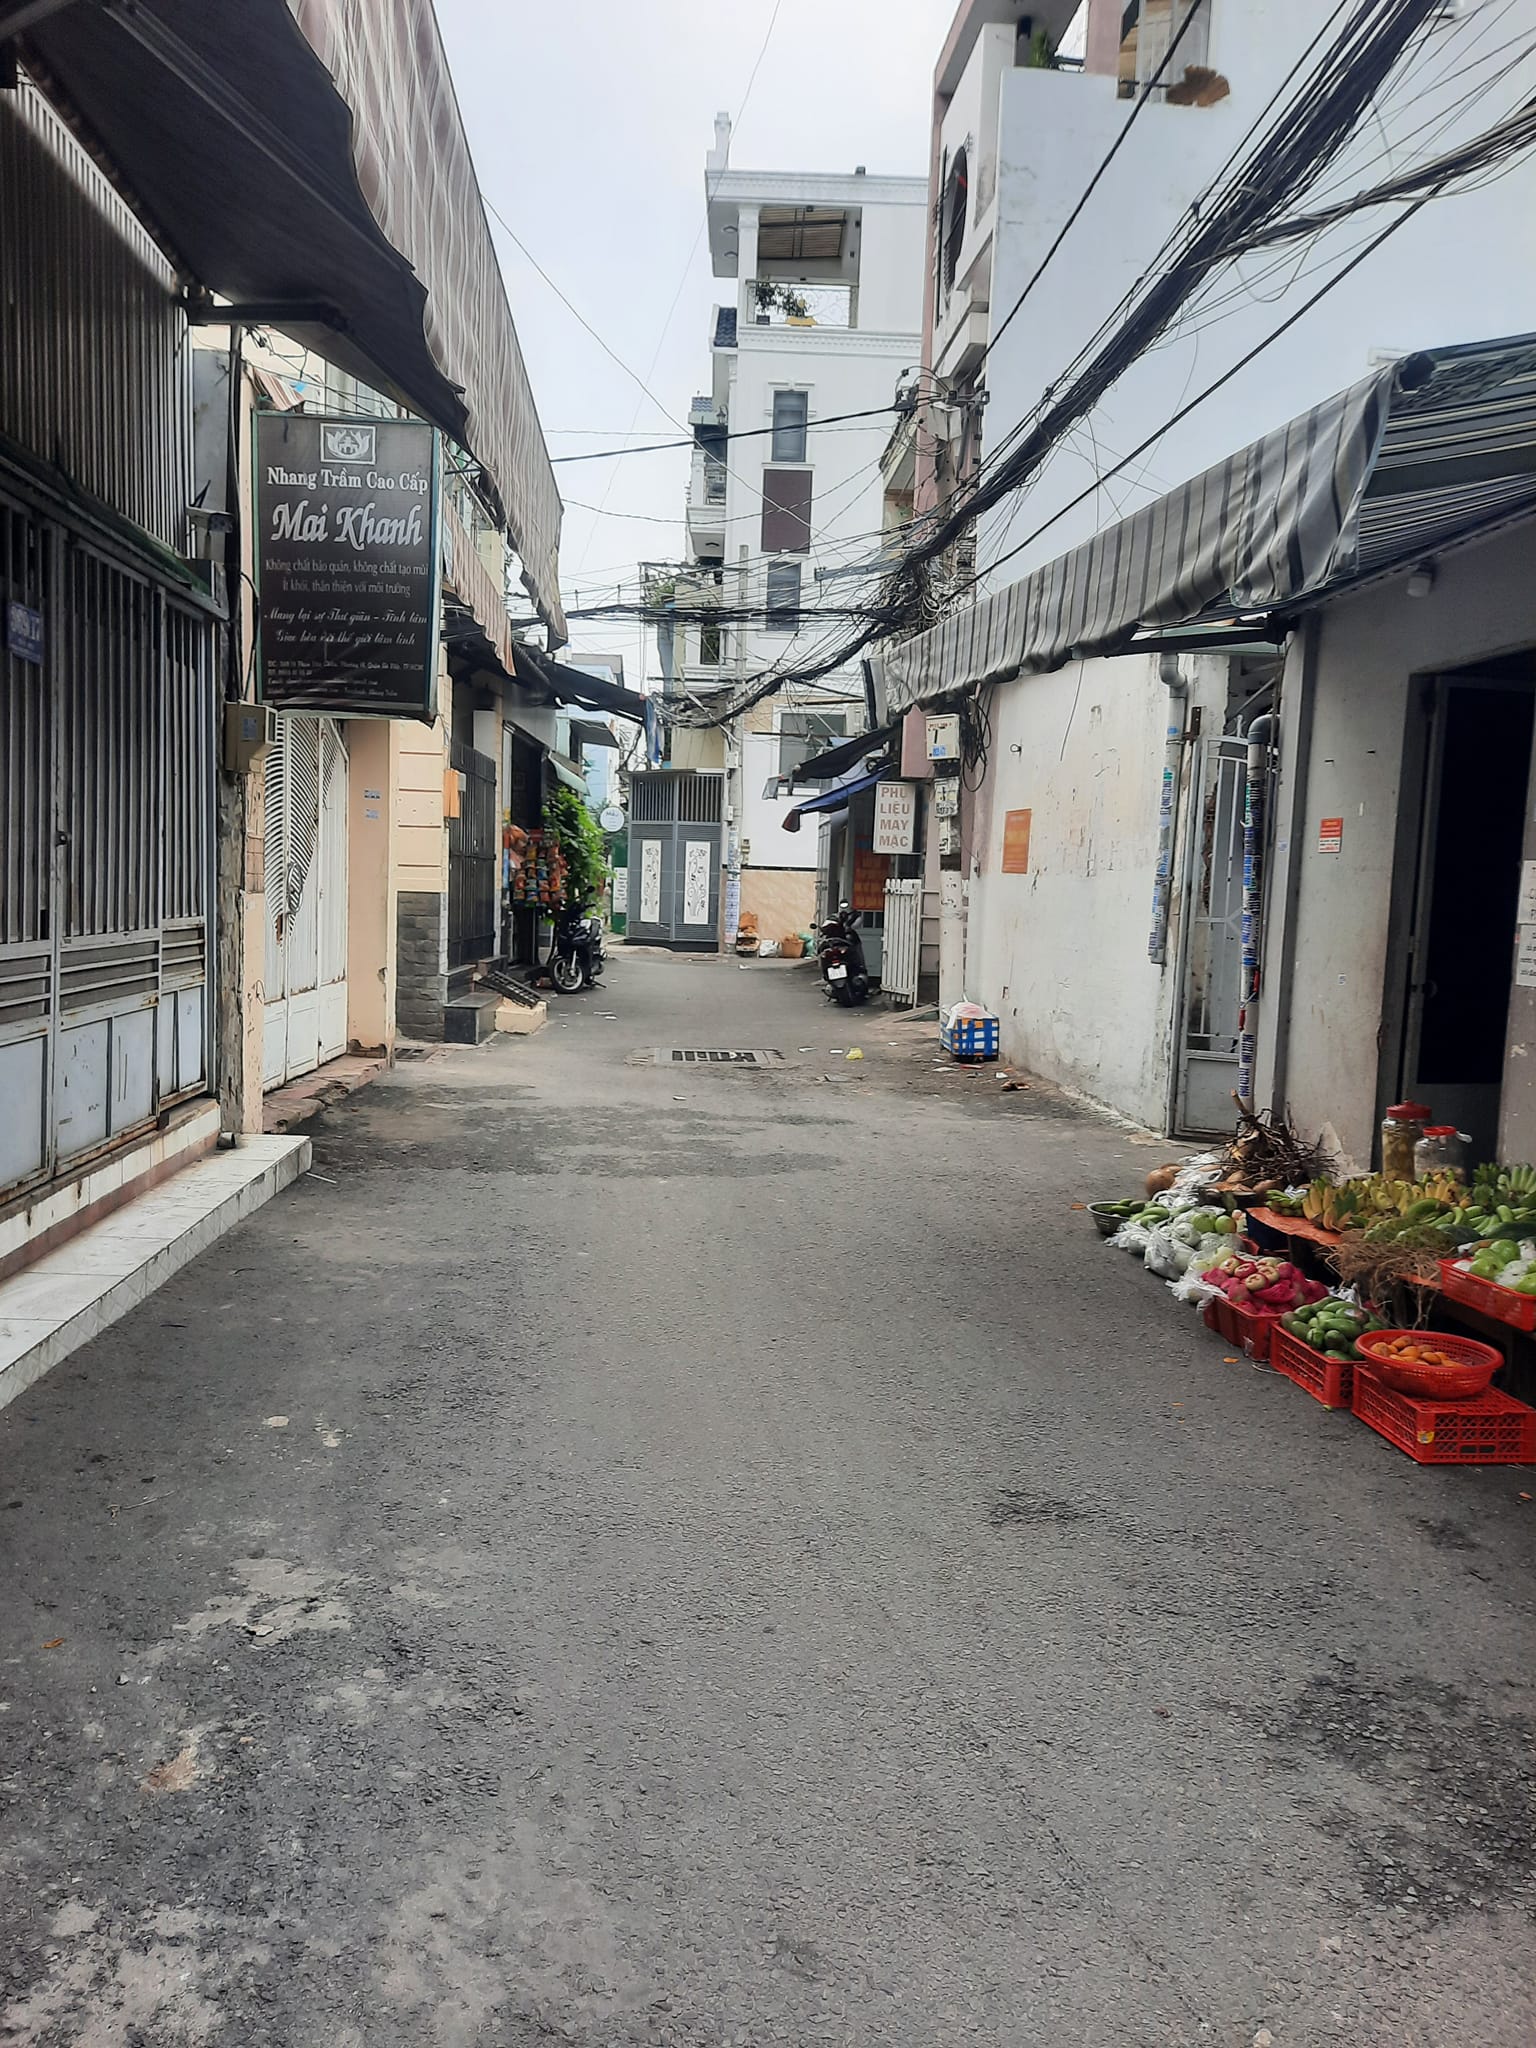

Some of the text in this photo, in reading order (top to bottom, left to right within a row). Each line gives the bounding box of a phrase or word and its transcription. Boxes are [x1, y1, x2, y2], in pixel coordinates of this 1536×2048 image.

[267, 467, 428, 495] Nhang Trầm Cao Cấp
[271, 500, 423, 550] Mai Khanh
[379, 561, 397, 575] chất
[880, 819, 910, 830] MAY
